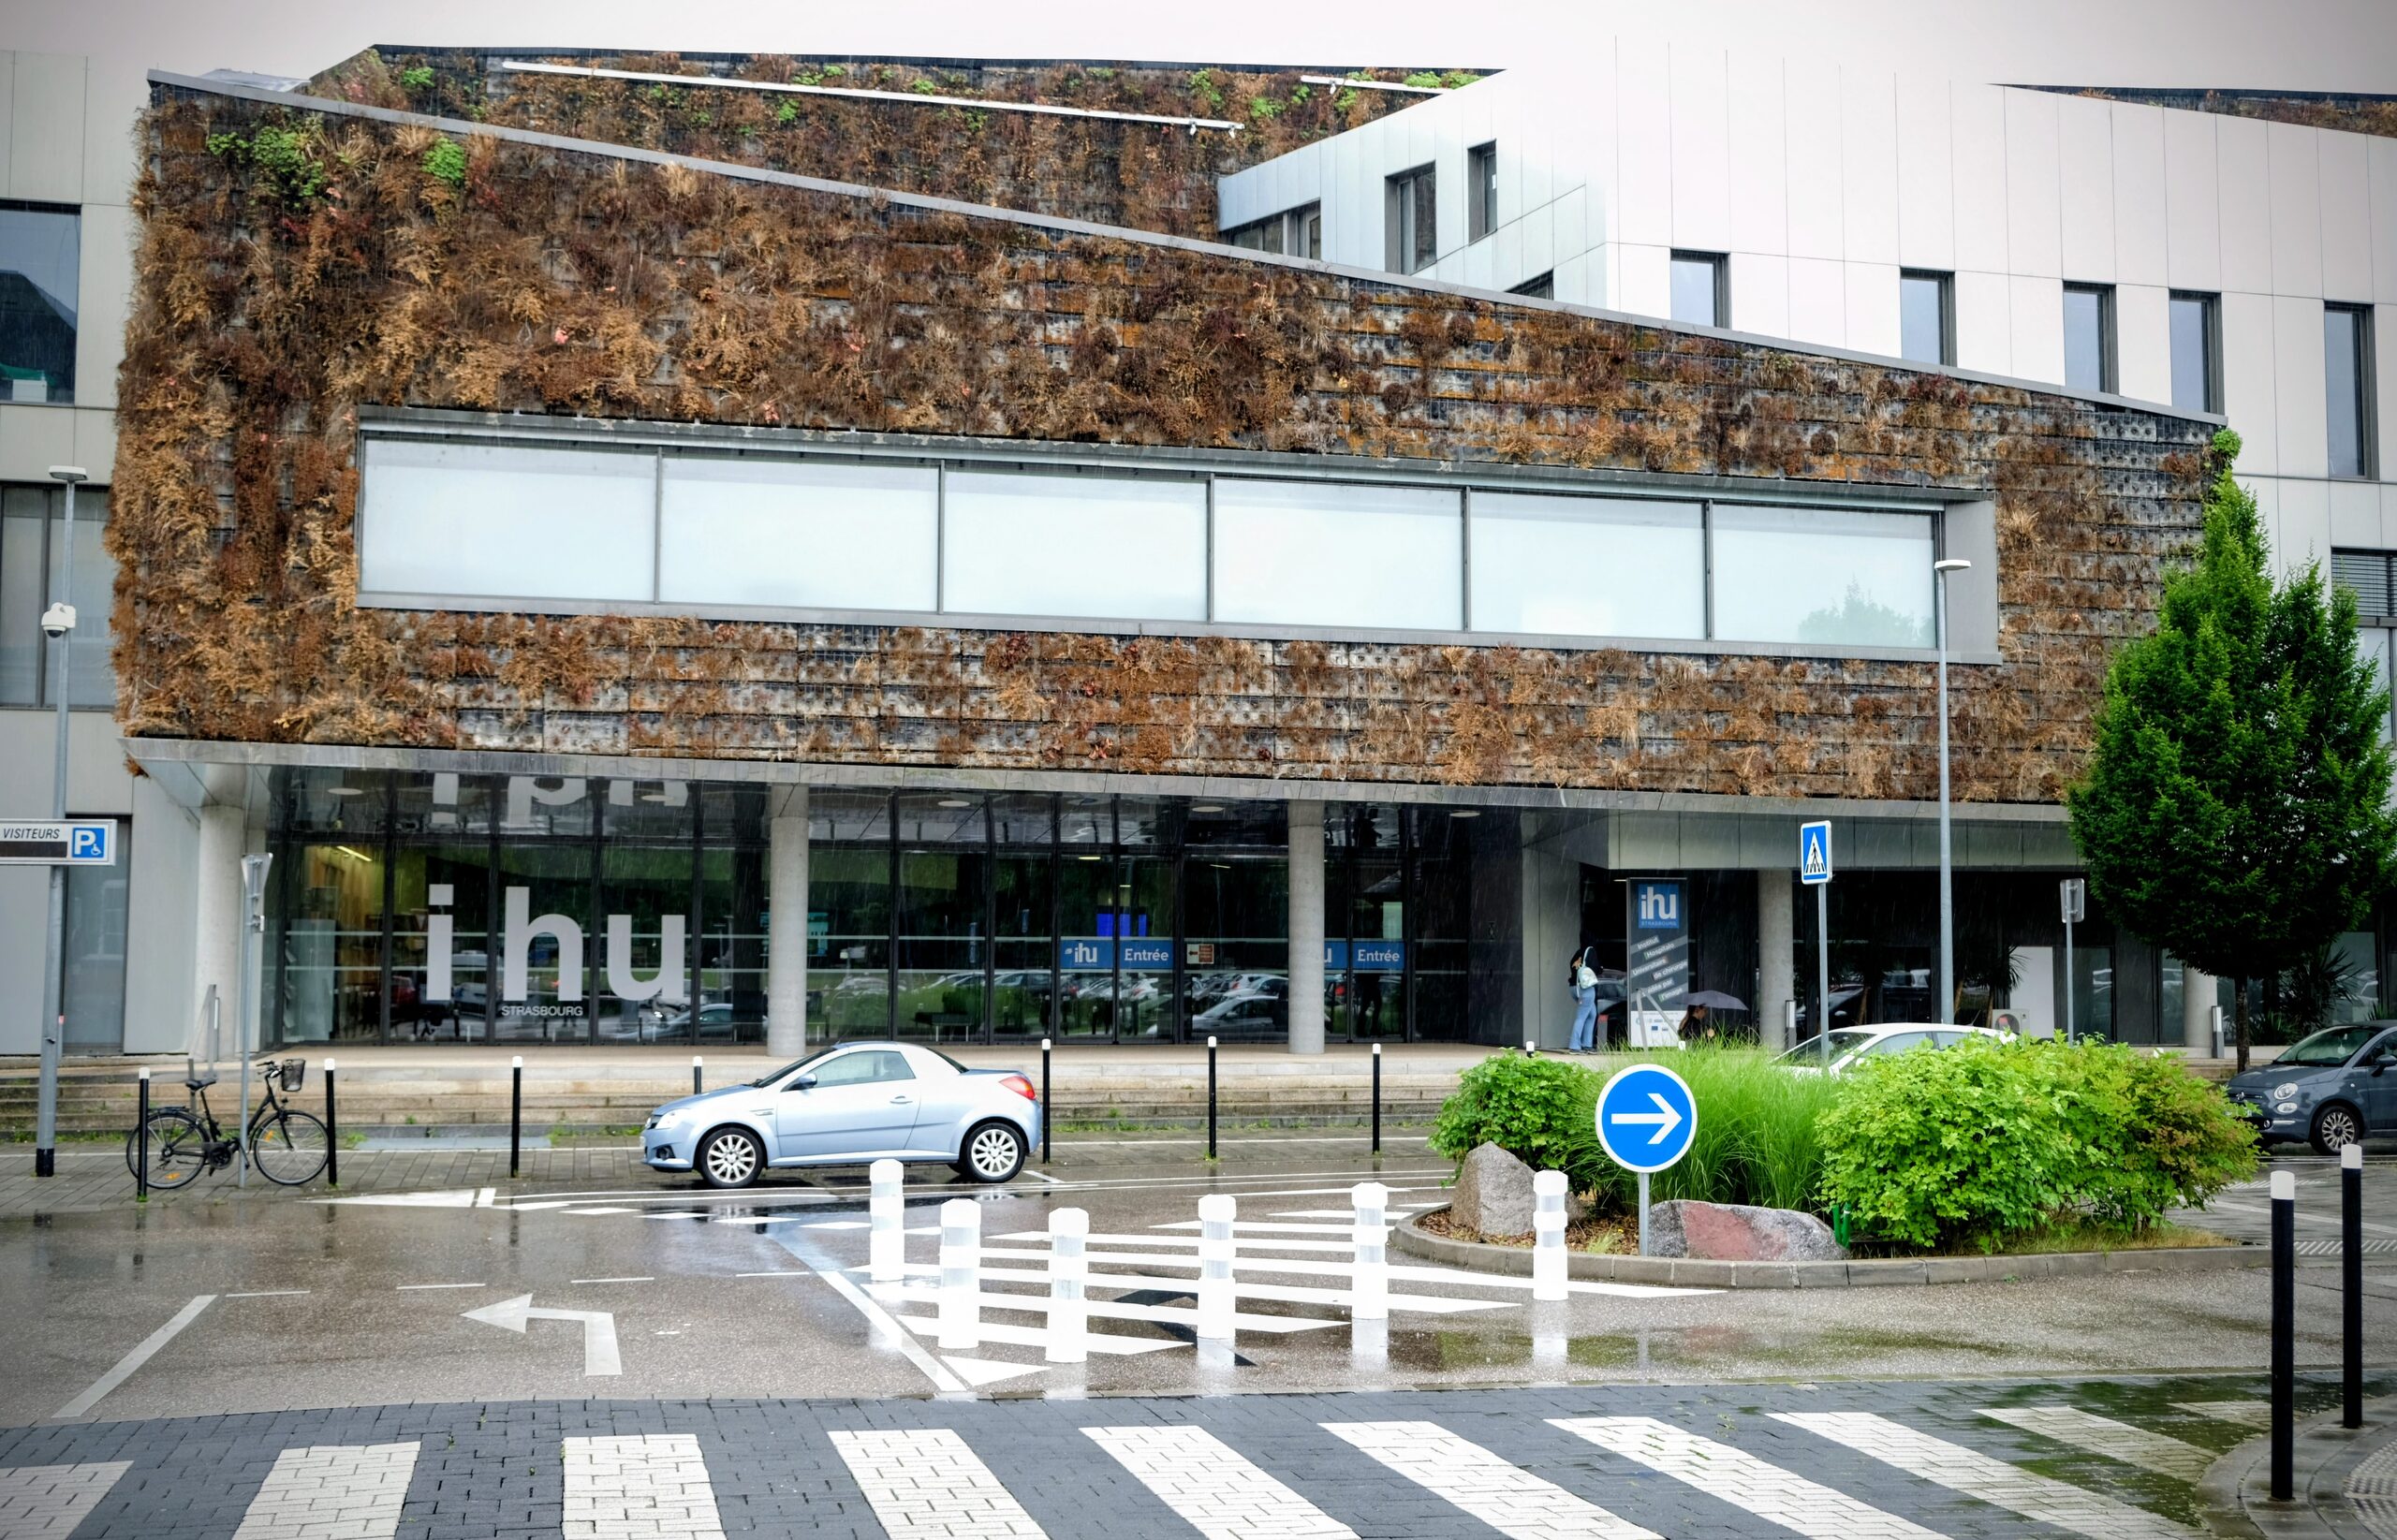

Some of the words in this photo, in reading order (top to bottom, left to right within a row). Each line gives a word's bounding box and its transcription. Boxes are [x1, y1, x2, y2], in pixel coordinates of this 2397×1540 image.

[3, 828, 60, 839] VISITEURS
[74, 829, 96, 855] P
[1640, 886, 1677, 919] ihu
[426, 884, 685, 1001] ihu
[1637, 936, 1659, 949] Institut
[1074, 942, 1098, 963] ihu
[1125, 948, 1169, 961] Entrée
[1358, 949, 1401, 961] Entrée
[501, 1005, 584, 1018] STRASBOURG
